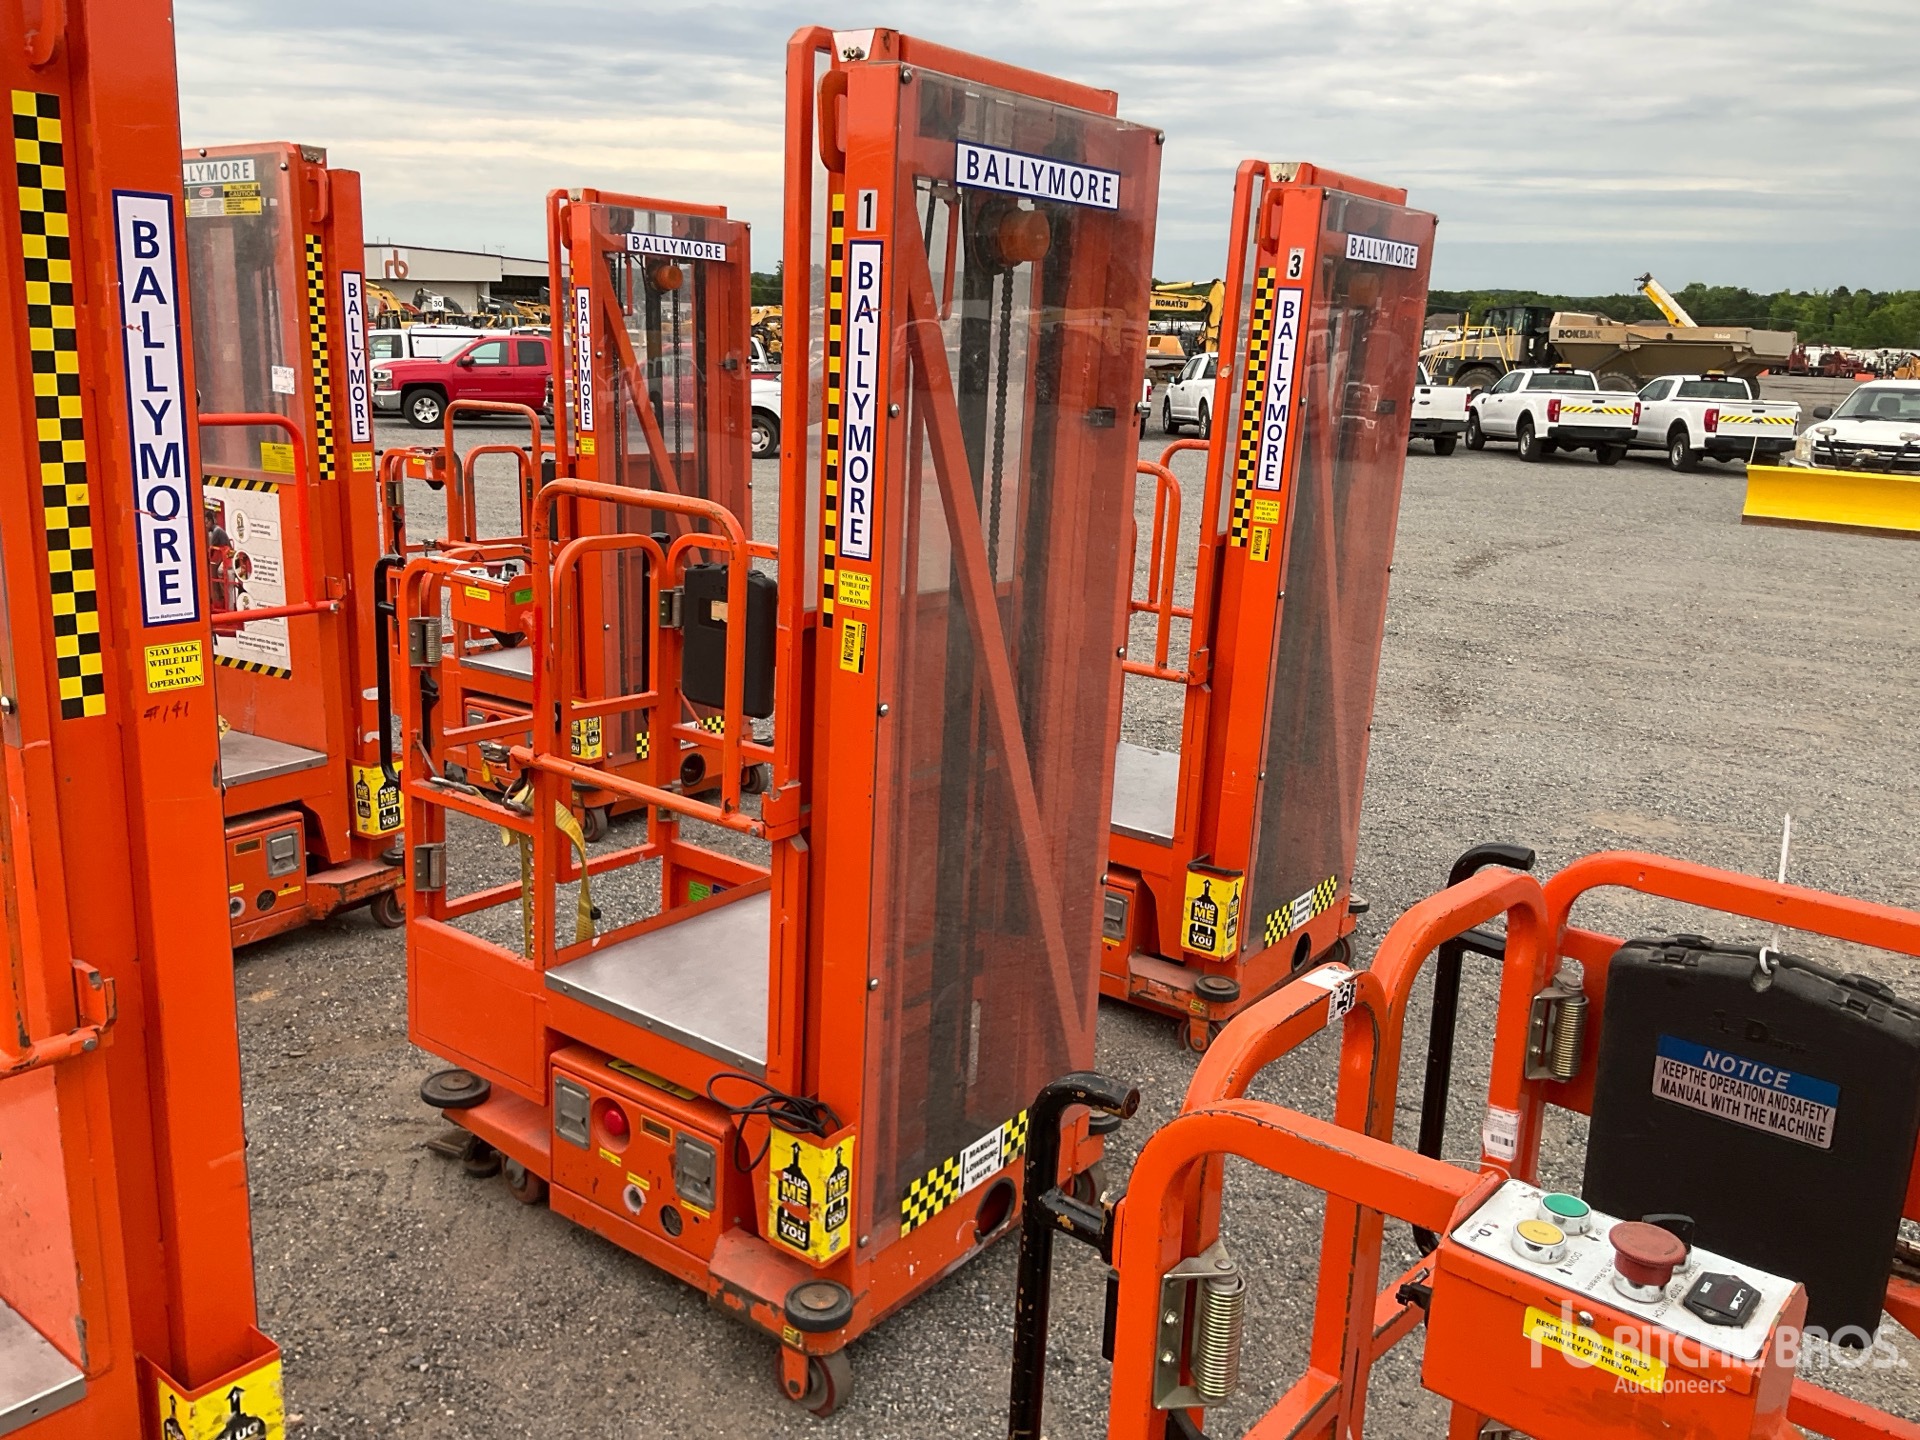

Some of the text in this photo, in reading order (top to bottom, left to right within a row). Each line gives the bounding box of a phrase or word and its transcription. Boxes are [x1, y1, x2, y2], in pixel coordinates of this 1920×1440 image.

[184, 161, 250, 182] LYMORE
[966, 149, 1112, 204] BALLYMORE
[863, 192, 872, 228] 1
[632, 236, 723, 259] BALLYMORE
[1349, 237, 1415, 266] BALLYMORE
[385, 248, 409, 279] rb
[1290, 254, 1301, 278] 3
[433, 300, 443, 308] 30
[1155, 299, 1189, 308] KOMATSU
[1558, 328, 1601, 339] ROKBAK
[348, 282, 366, 435] BALLYMORE
[580, 296, 592, 426] BALLYMORE
[1265, 301, 1294, 482] BALLYMORE
[131, 219, 182, 606] BALLYMORE
[848, 260, 874, 546] BALLYMORE
[840, 580, 870, 591] WHILE LIFT
[854, 575, 870, 583] BACK
[839, 596, 870, 607] OPERATION
[149, 643, 198, 658] STAY BACK
[149, 653, 200, 668] WHILE LIFT
[149, 674, 202, 689] OPERATION
[165, 666, 186, 676] IS IN
[380, 786, 397, 795] PLUG
[380, 791, 397, 804] ME
[382, 815, 399, 825] YOU
[1194, 900, 1216, 911] PLUG
[1194, 907, 1215, 921] ME
[1191, 933, 1213, 947] YOU
[1702, 1050, 1791, 1090] NOTICE
[1662, 1059, 1688, 1078] KEEP
[1689, 1066, 1708, 1087] THE
[1709, 1073, 1766, 1105] OPERATION
[1660, 1077, 1827, 1143] MANUAL WITH THE MACHINE
[969, 1136, 997, 1159] MANUAL
[966, 1146, 999, 1174] LOWERING
[782, 1171, 809, 1191] PLUG
[829, 1169, 848, 1185] PLUG
[971, 1164, 992, 1183] VALVE
[781, 1180, 808, 1206] ME
[828, 1178, 847, 1199] ME
[827, 1209, 846, 1226] YOU
[781, 1221, 806, 1243] YOU
[1563, 1251, 1583, 1268] DOWN
[1584, 1271, 1606, 1292] Release
[1652, 1283, 1684, 1319] STOP SWITCH
[1535, 1318, 1651, 1372] RESET LIFT IF TIMER EXPIRES,
[1543, 1331, 1640, 1377] TURN KEY OFF THEN ON.
